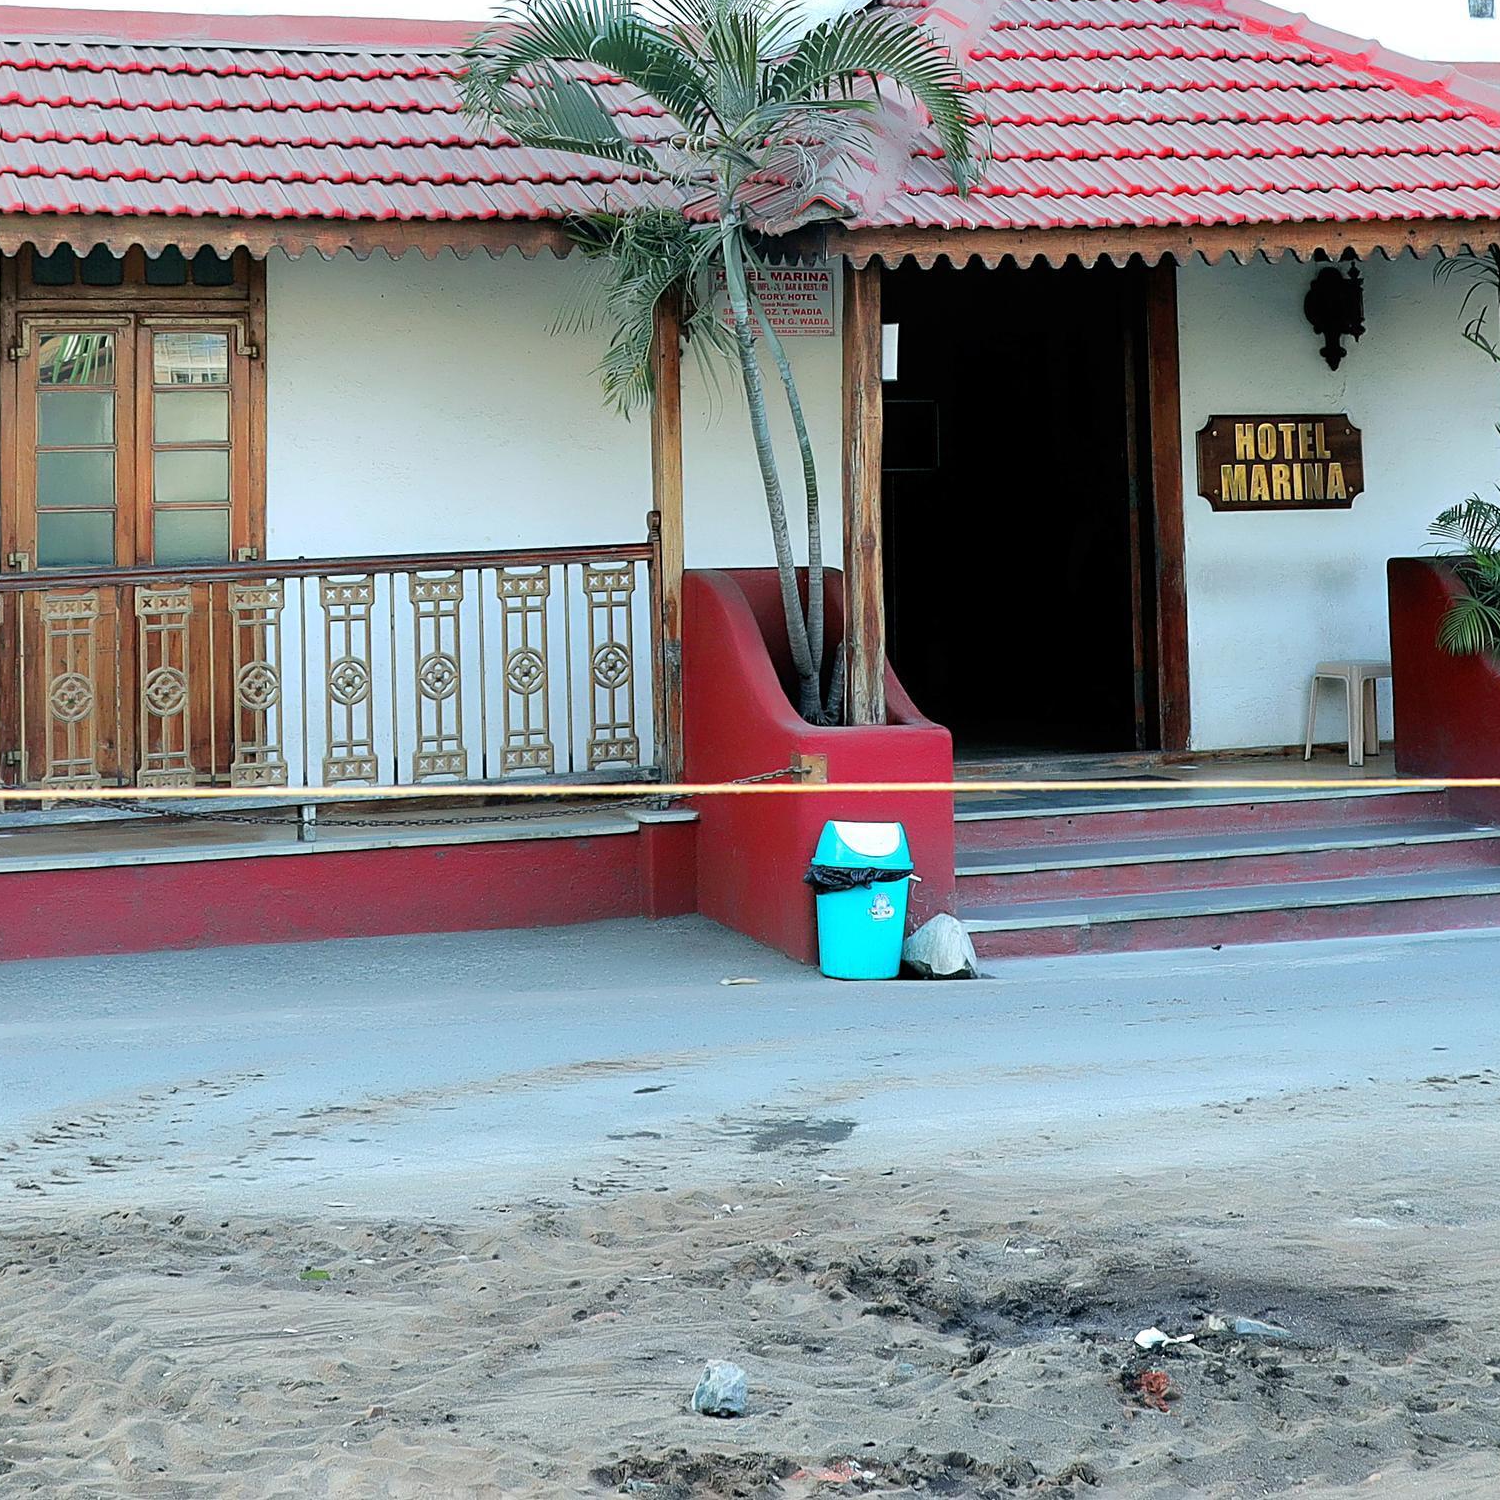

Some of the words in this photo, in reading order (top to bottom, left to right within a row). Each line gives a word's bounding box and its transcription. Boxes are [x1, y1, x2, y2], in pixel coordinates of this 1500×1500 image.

[716, 271, 766, 281] HEL
[770, 271, 829, 282] MARINA
[787, 293, 818, 301] HOTEL
[792, 308, 822, 316] WADIA
[1234, 422, 1332, 461] HOTEL
[1220, 462, 1347, 502] MARINA
